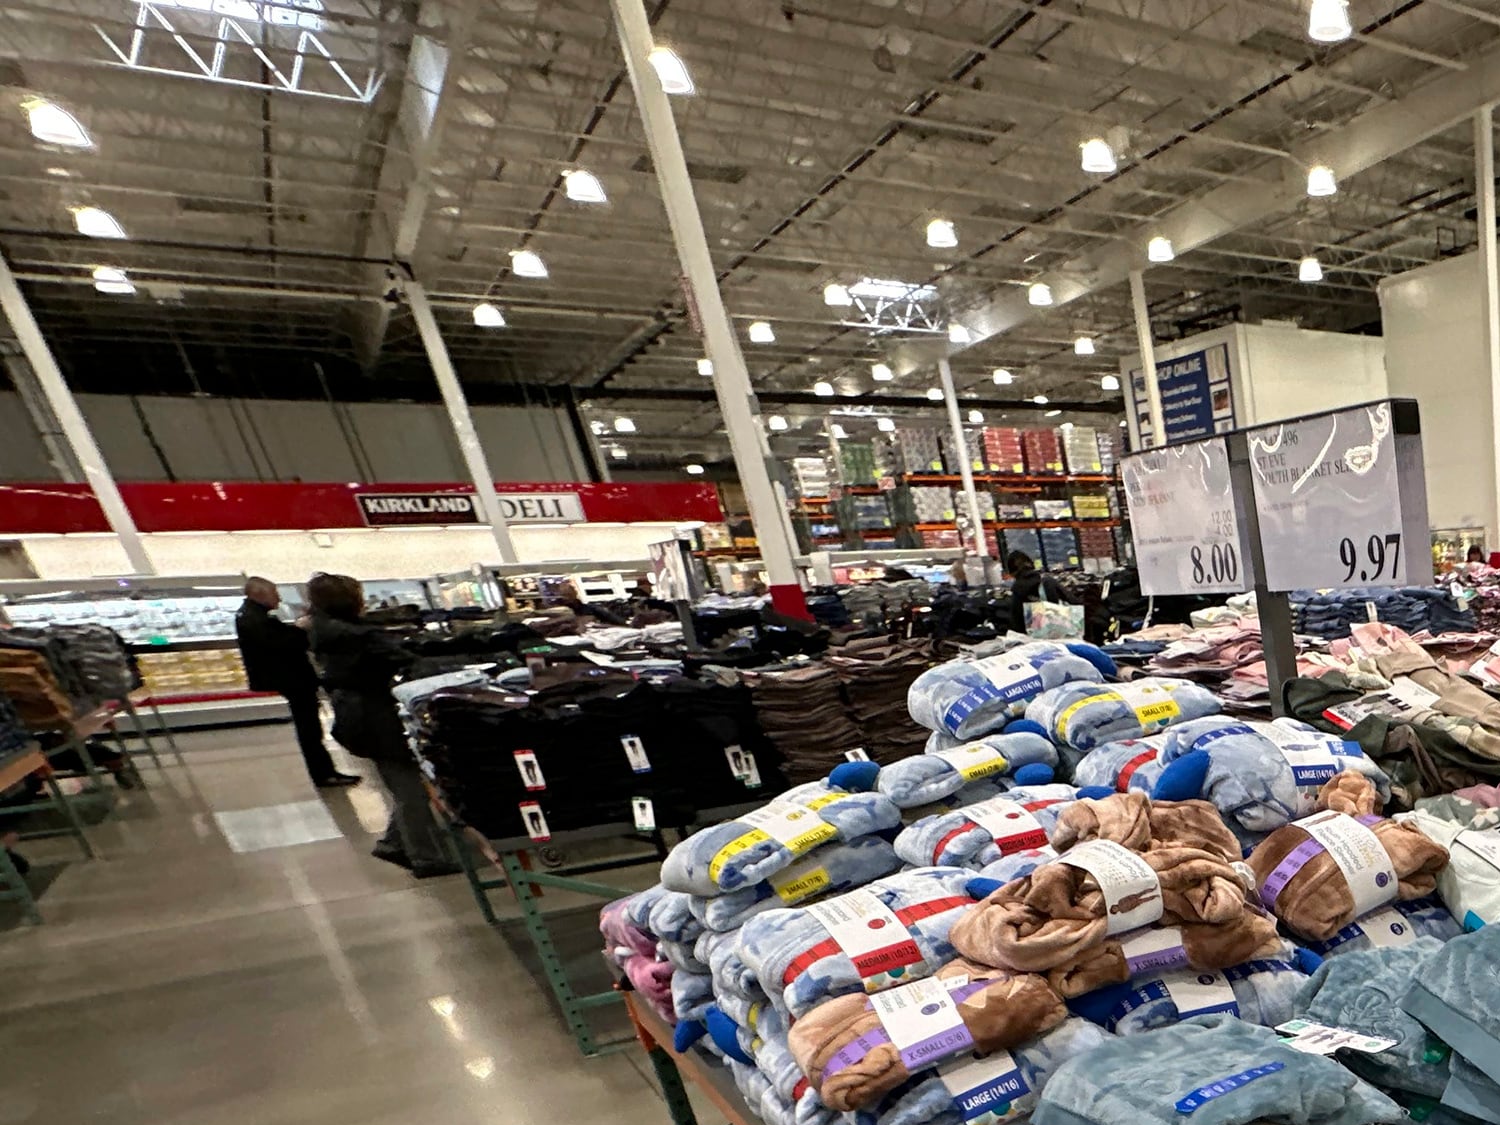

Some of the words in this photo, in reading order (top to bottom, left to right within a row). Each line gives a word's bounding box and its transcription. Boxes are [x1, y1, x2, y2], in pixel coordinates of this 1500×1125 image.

[365, 497, 471, 514] KIRKLAND
[502, 499, 565, 520] DELI
[1191, 543, 1237, 584] 8.00
[1340, 533, 1400, 584] 9.97
[1005, 686, 1023, 698] LARGE
[1142, 707, 1159, 717] SMALL
[1297, 769, 1316, 780] LARGE
[857, 953, 890, 969] MEDIUM
[908, 1040, 945, 1061] X-SMALL
[963, 1091, 990, 1111] LARGE
[990, 1078, 1020, 1100] (14/16)
